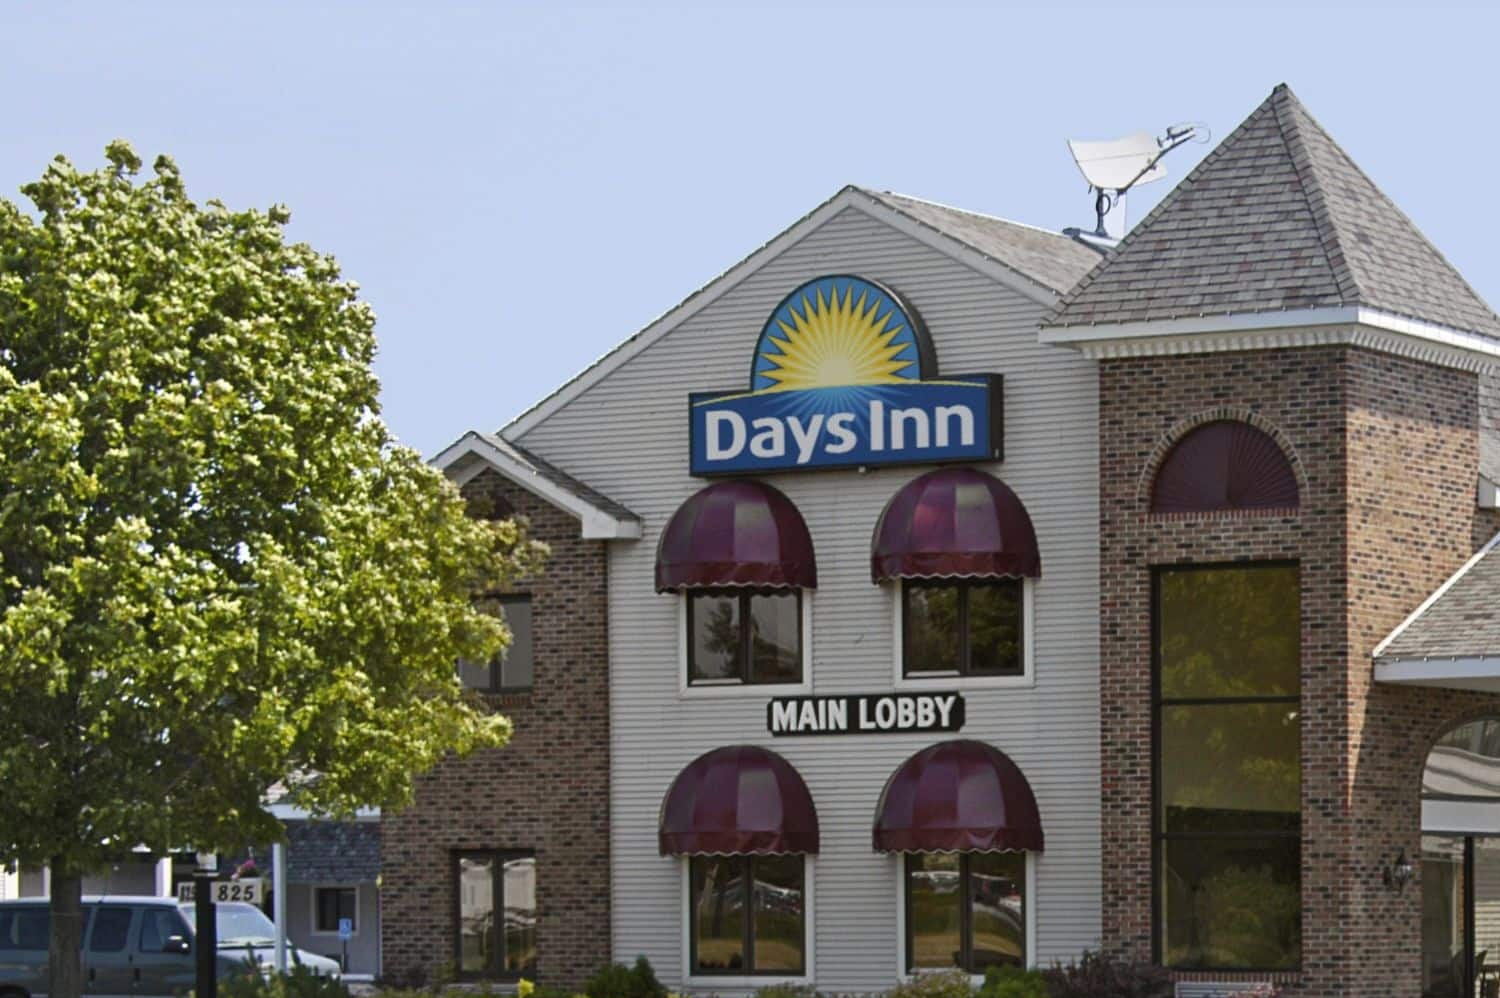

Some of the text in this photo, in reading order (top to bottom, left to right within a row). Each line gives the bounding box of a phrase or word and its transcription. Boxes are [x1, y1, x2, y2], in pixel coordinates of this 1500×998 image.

[705, 400, 974, 464] Days Inn
[772, 696, 956, 732] MAIN LOBBY
[218, 884, 254, 902] 825
